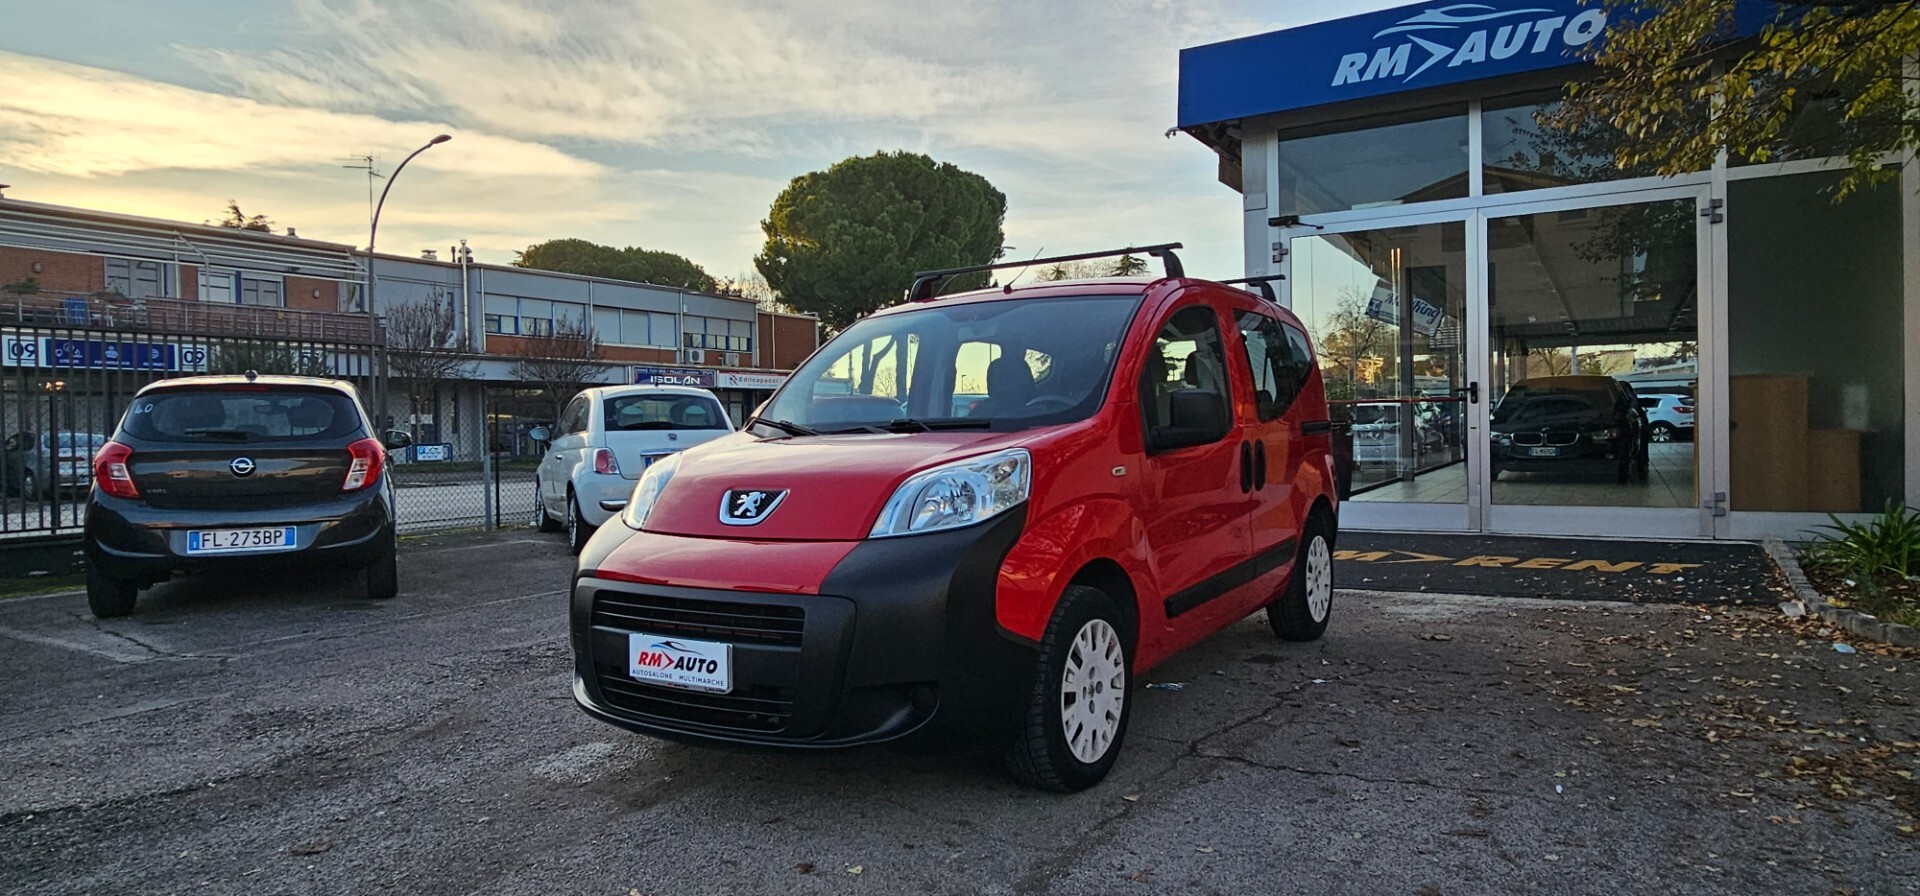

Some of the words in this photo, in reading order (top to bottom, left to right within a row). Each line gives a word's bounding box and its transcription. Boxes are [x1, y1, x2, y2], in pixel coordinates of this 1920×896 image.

[1331, 43, 1412, 87] RM
[1447, 8, 1608, 68] AUTO
[183, 350, 204, 364] 09
[650, 375, 700, 386] ISOLAN
[1452, 555, 1705, 575] RENT
[638, 650, 662, 667] RM
[673, 655, 718, 674] AUTO
[632, 669, 673, 679] AUTOSALONE
[678, 674, 725, 686] MULTIMARCHE
